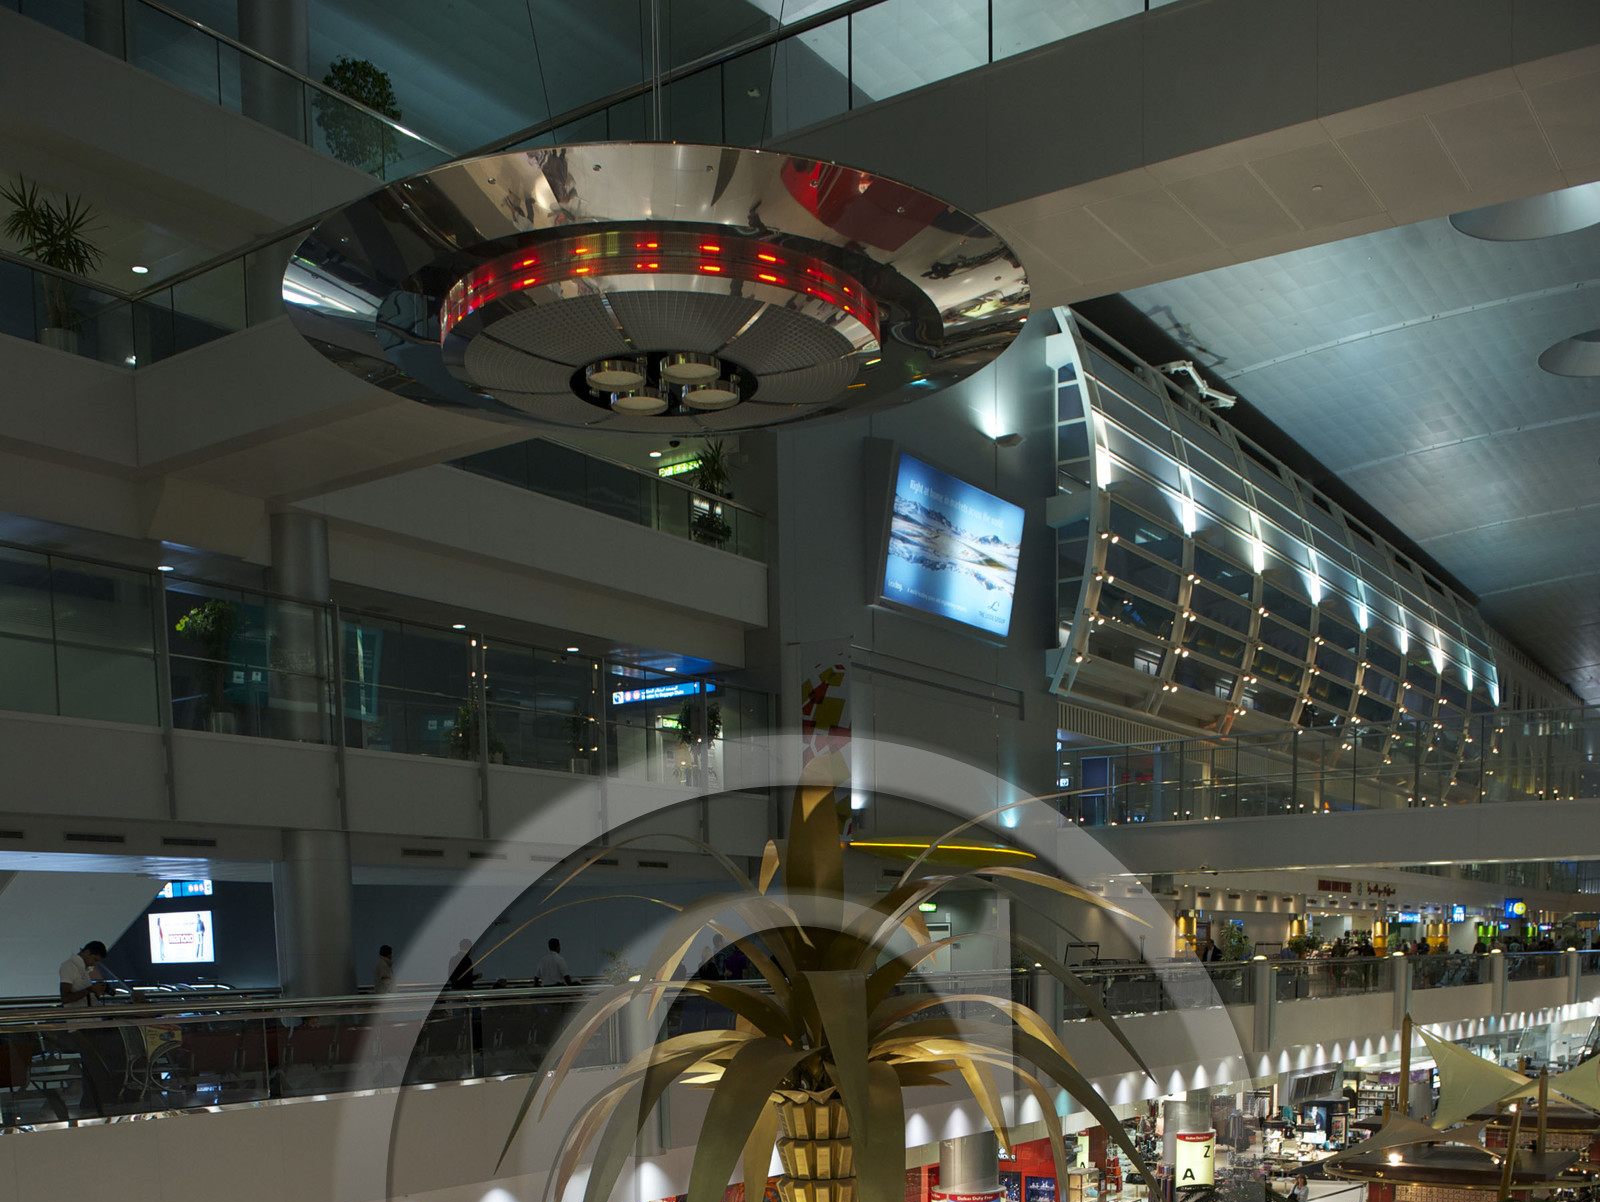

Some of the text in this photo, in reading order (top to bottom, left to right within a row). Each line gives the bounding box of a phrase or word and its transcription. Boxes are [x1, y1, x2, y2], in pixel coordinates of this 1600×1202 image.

[910, 479, 923, 494] Right
[1203, 1145, 1211, 1158] Z
[1182, 1168, 1195, 1180] A
